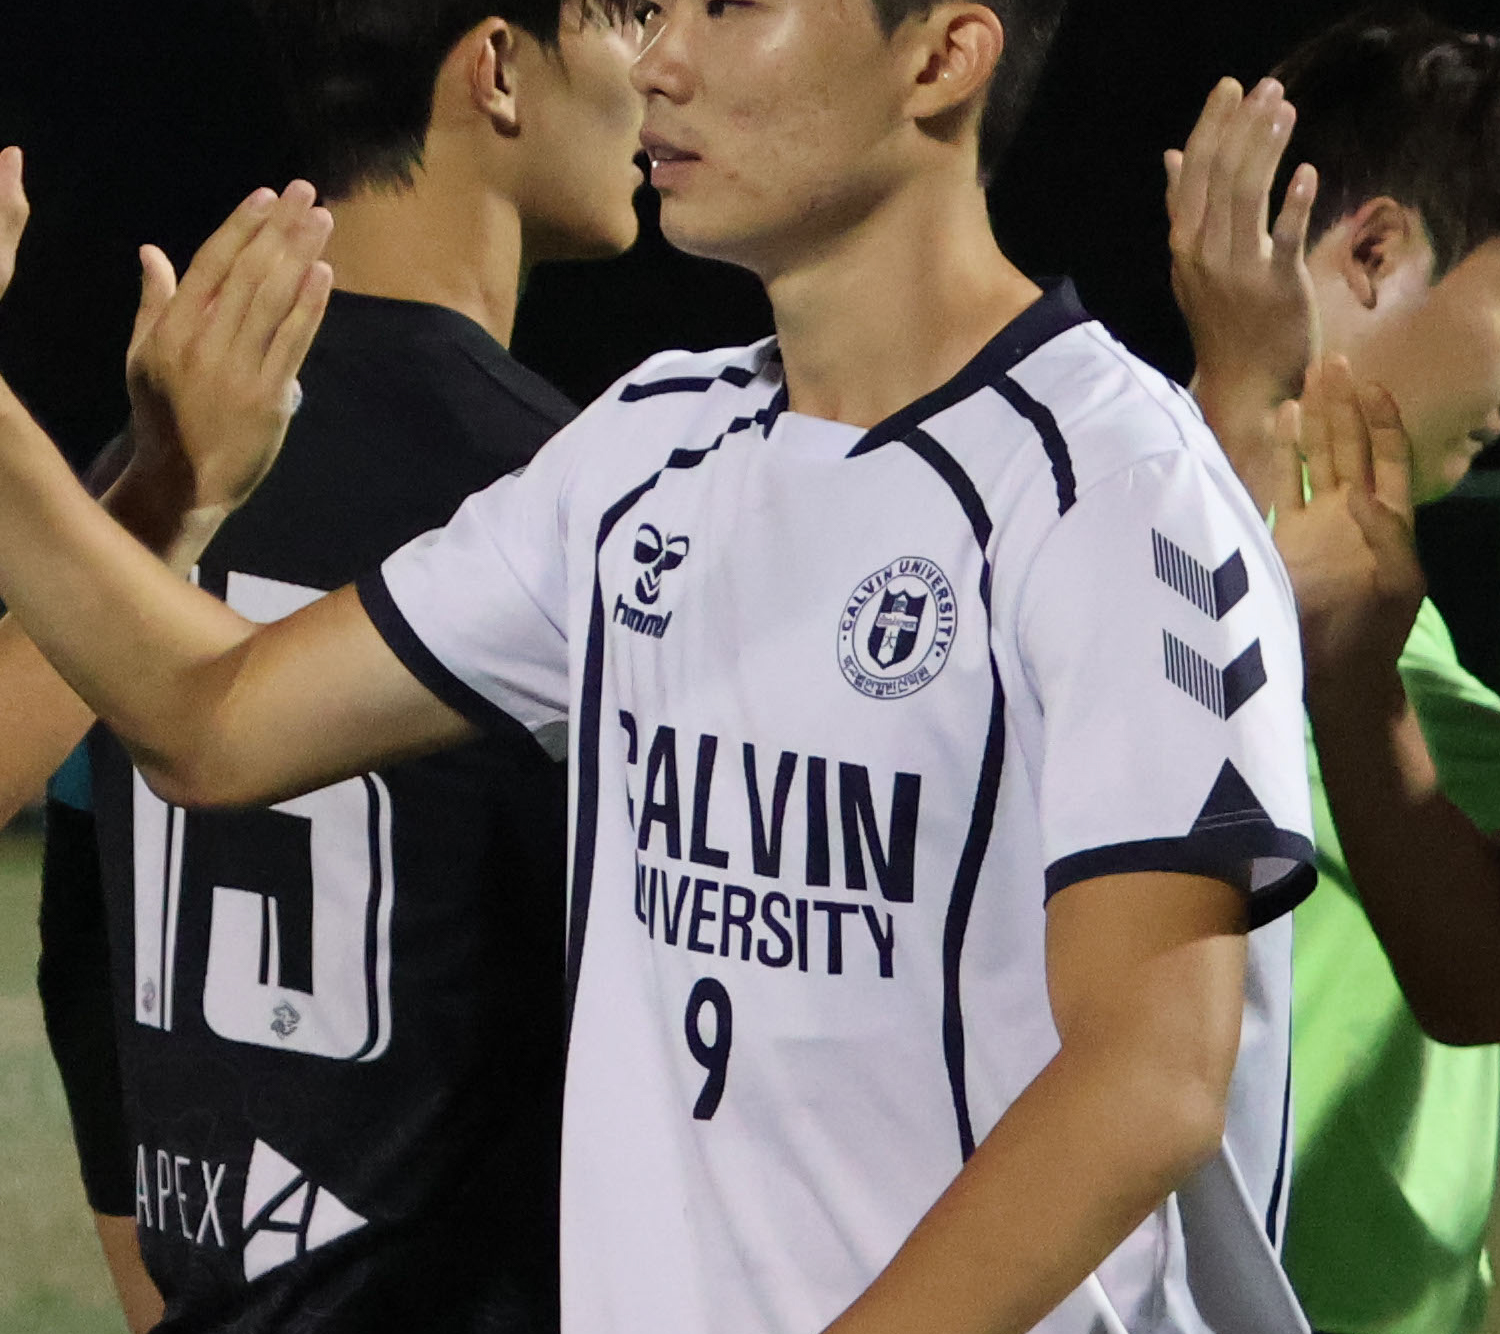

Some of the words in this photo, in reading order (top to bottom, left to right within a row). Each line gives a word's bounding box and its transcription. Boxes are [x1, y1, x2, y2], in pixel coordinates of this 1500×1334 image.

[842, 568, 893, 632] CALVIN
[899, 560, 954, 654] UNIVERSITY
[683, 977, 734, 1121] 9
[135, 1142, 227, 1249] APEX
